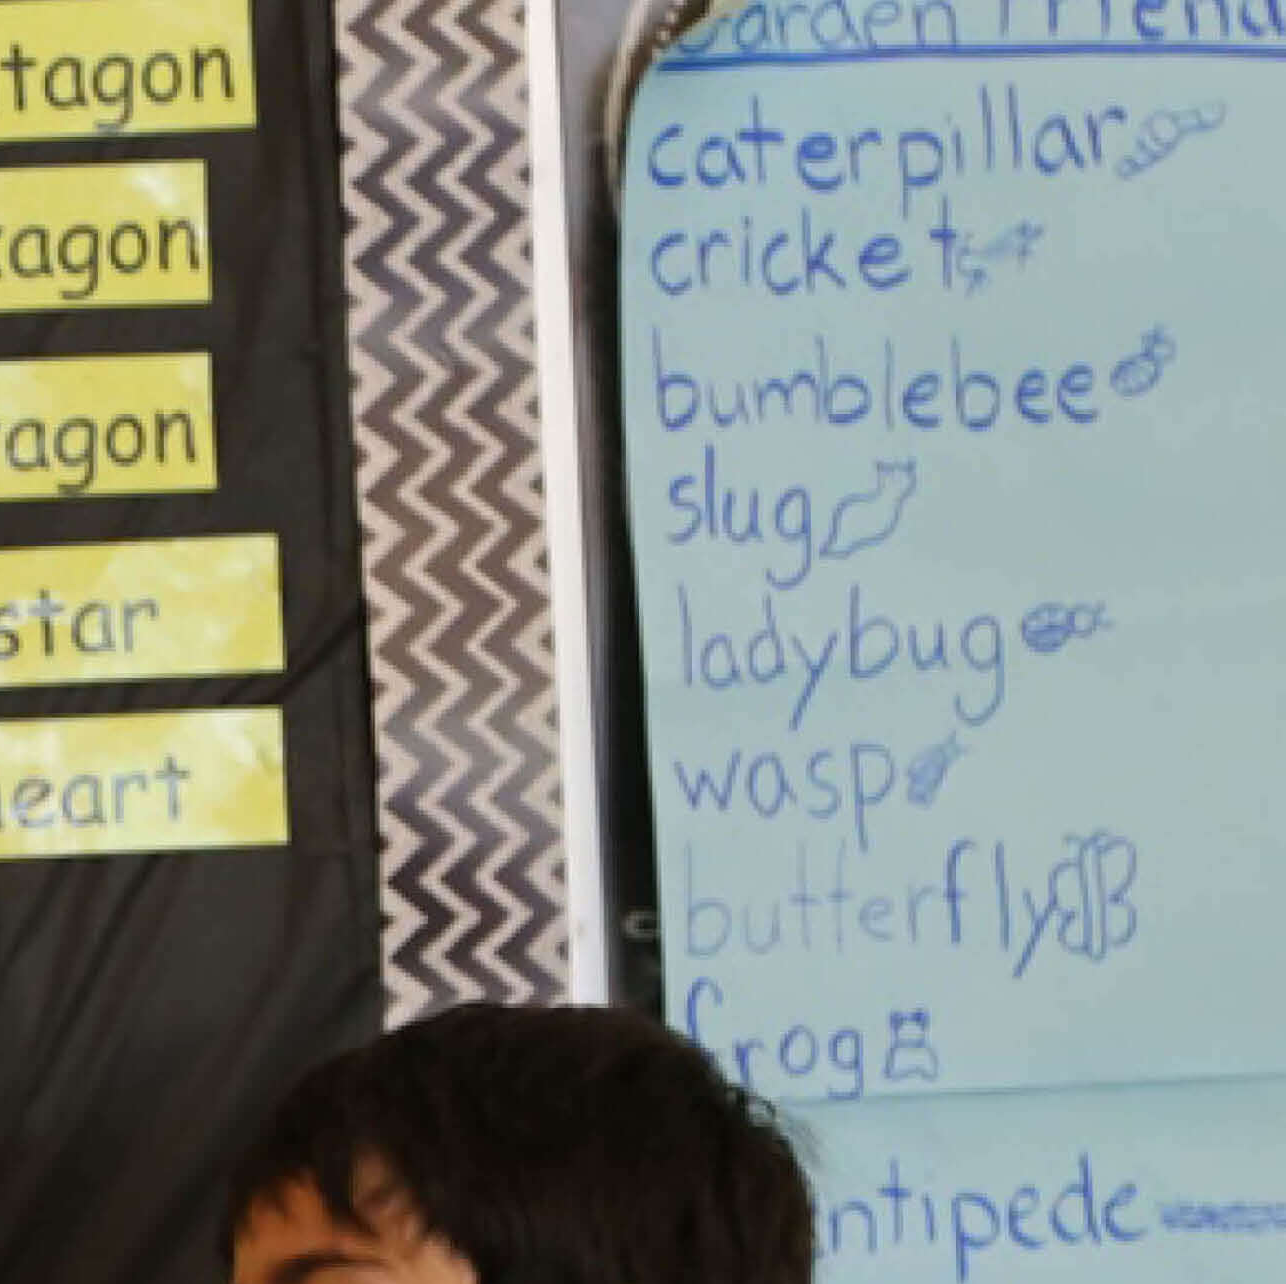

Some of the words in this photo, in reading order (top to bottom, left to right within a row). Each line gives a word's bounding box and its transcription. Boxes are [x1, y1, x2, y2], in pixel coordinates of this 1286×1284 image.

[648, 83, 1127, 220] caterpillar
[650, 194, 958, 294] cricket
[651, 325, 1100, 431] bumblebee
[668, 444, 812, 591] slug
[678, 583, 1006, 731] ladybug
[673, 741, 897, 852] wasp
[683, 838, 1056, 979] butterfly
[820, 1152, 1147, 1284] ntipede
